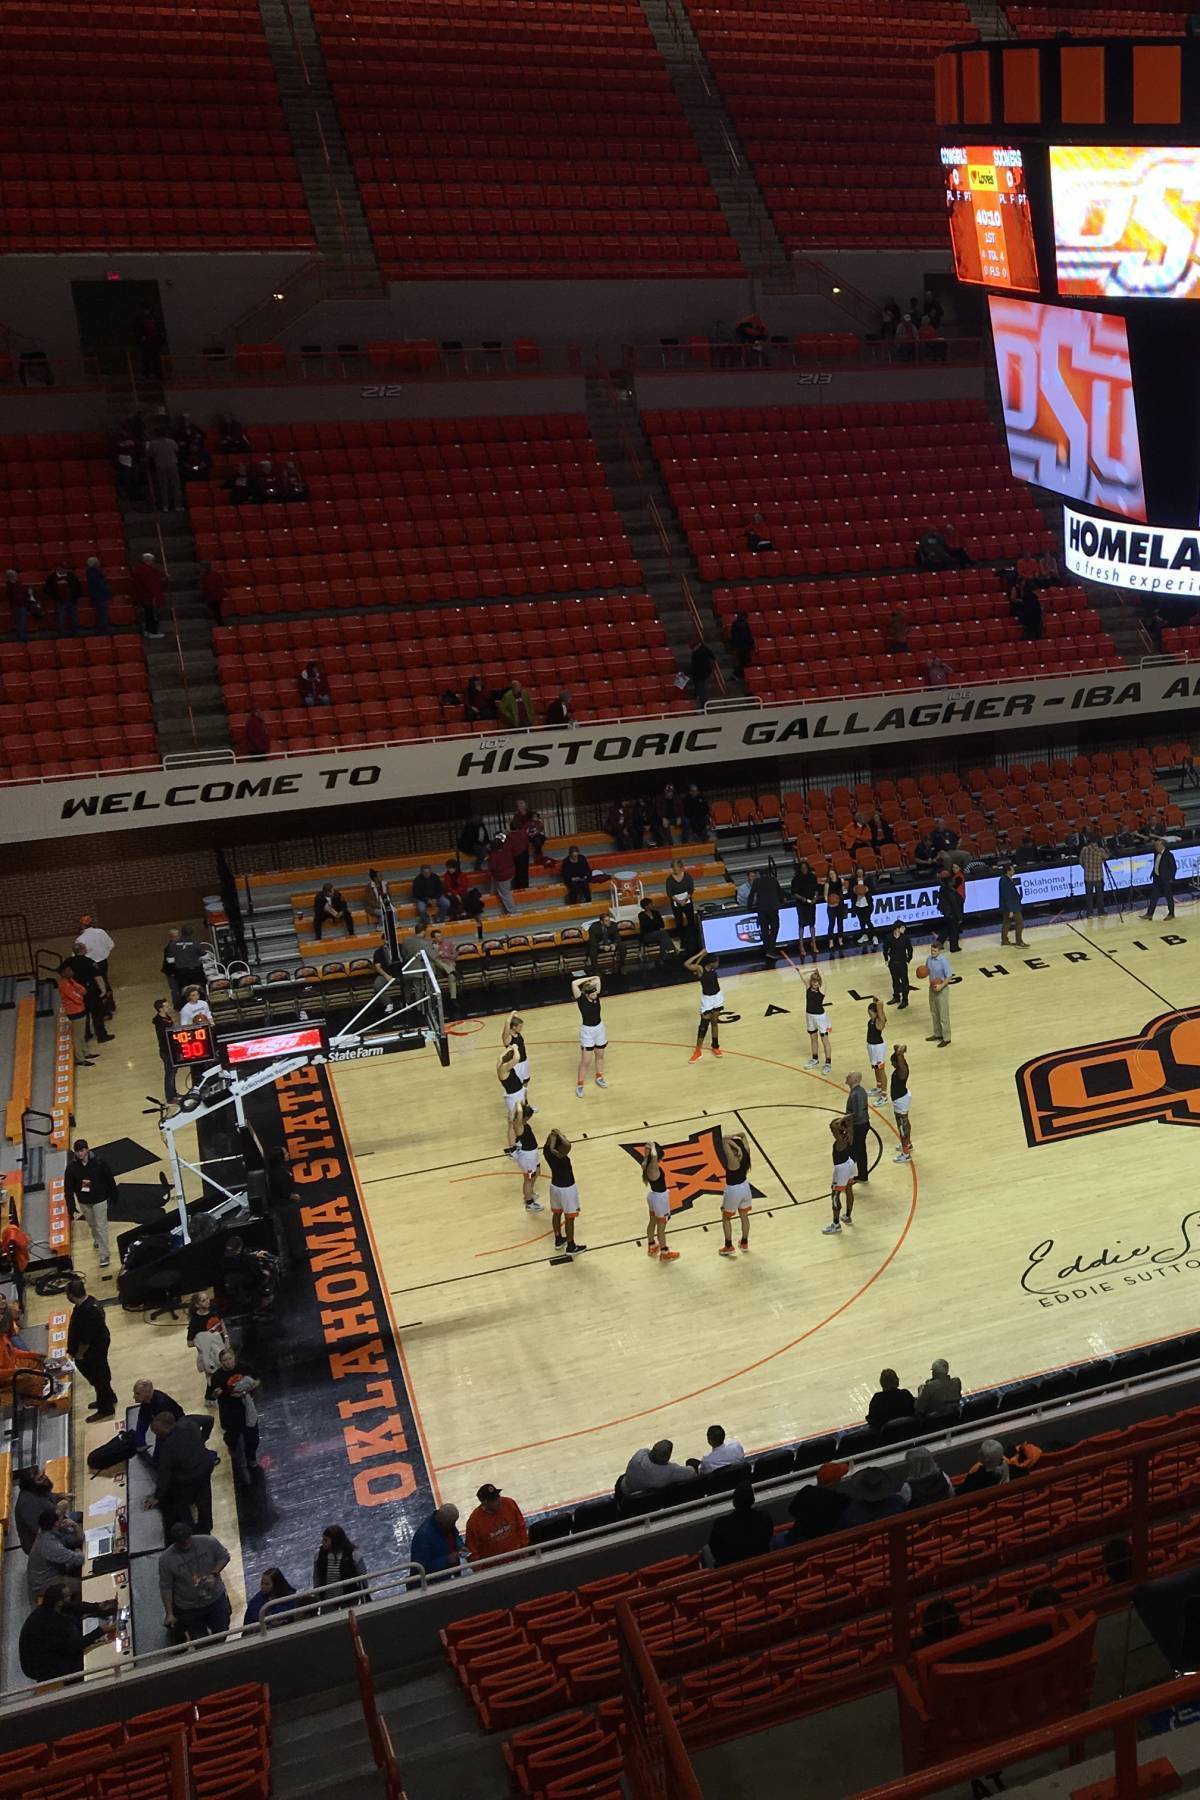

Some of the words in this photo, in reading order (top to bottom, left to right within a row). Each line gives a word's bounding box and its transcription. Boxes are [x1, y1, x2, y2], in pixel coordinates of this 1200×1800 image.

[799, 372, 833, 385] 213
[361, 385, 402, 399] 212
[1075, 561, 1081, 571] a
[1084, 561, 1121, 584] fresh
[457, 727, 723, 777] HISTORIC
[741, 681, 1142, 745] GALLAGHER-IBA
[61, 772, 302, 820] WELCOME
[319, 764, 381, 790] TO
[1023, 875, 1065, 889] Oklahoma
[1024, 885, 1047, 897] Blood
[1048, 880, 1085, 893] Institute
[172, 1028, 207, 1044] 40:10
[180, 1041, 205, 1059] 30
[273, 1064, 342, 1185] STATE
[1021, 1239, 1151, 1295] Eddie
[1039, 1282, 1114, 1308] EDDIE
[299, 1194, 416, 1507] OKLAHOMA
